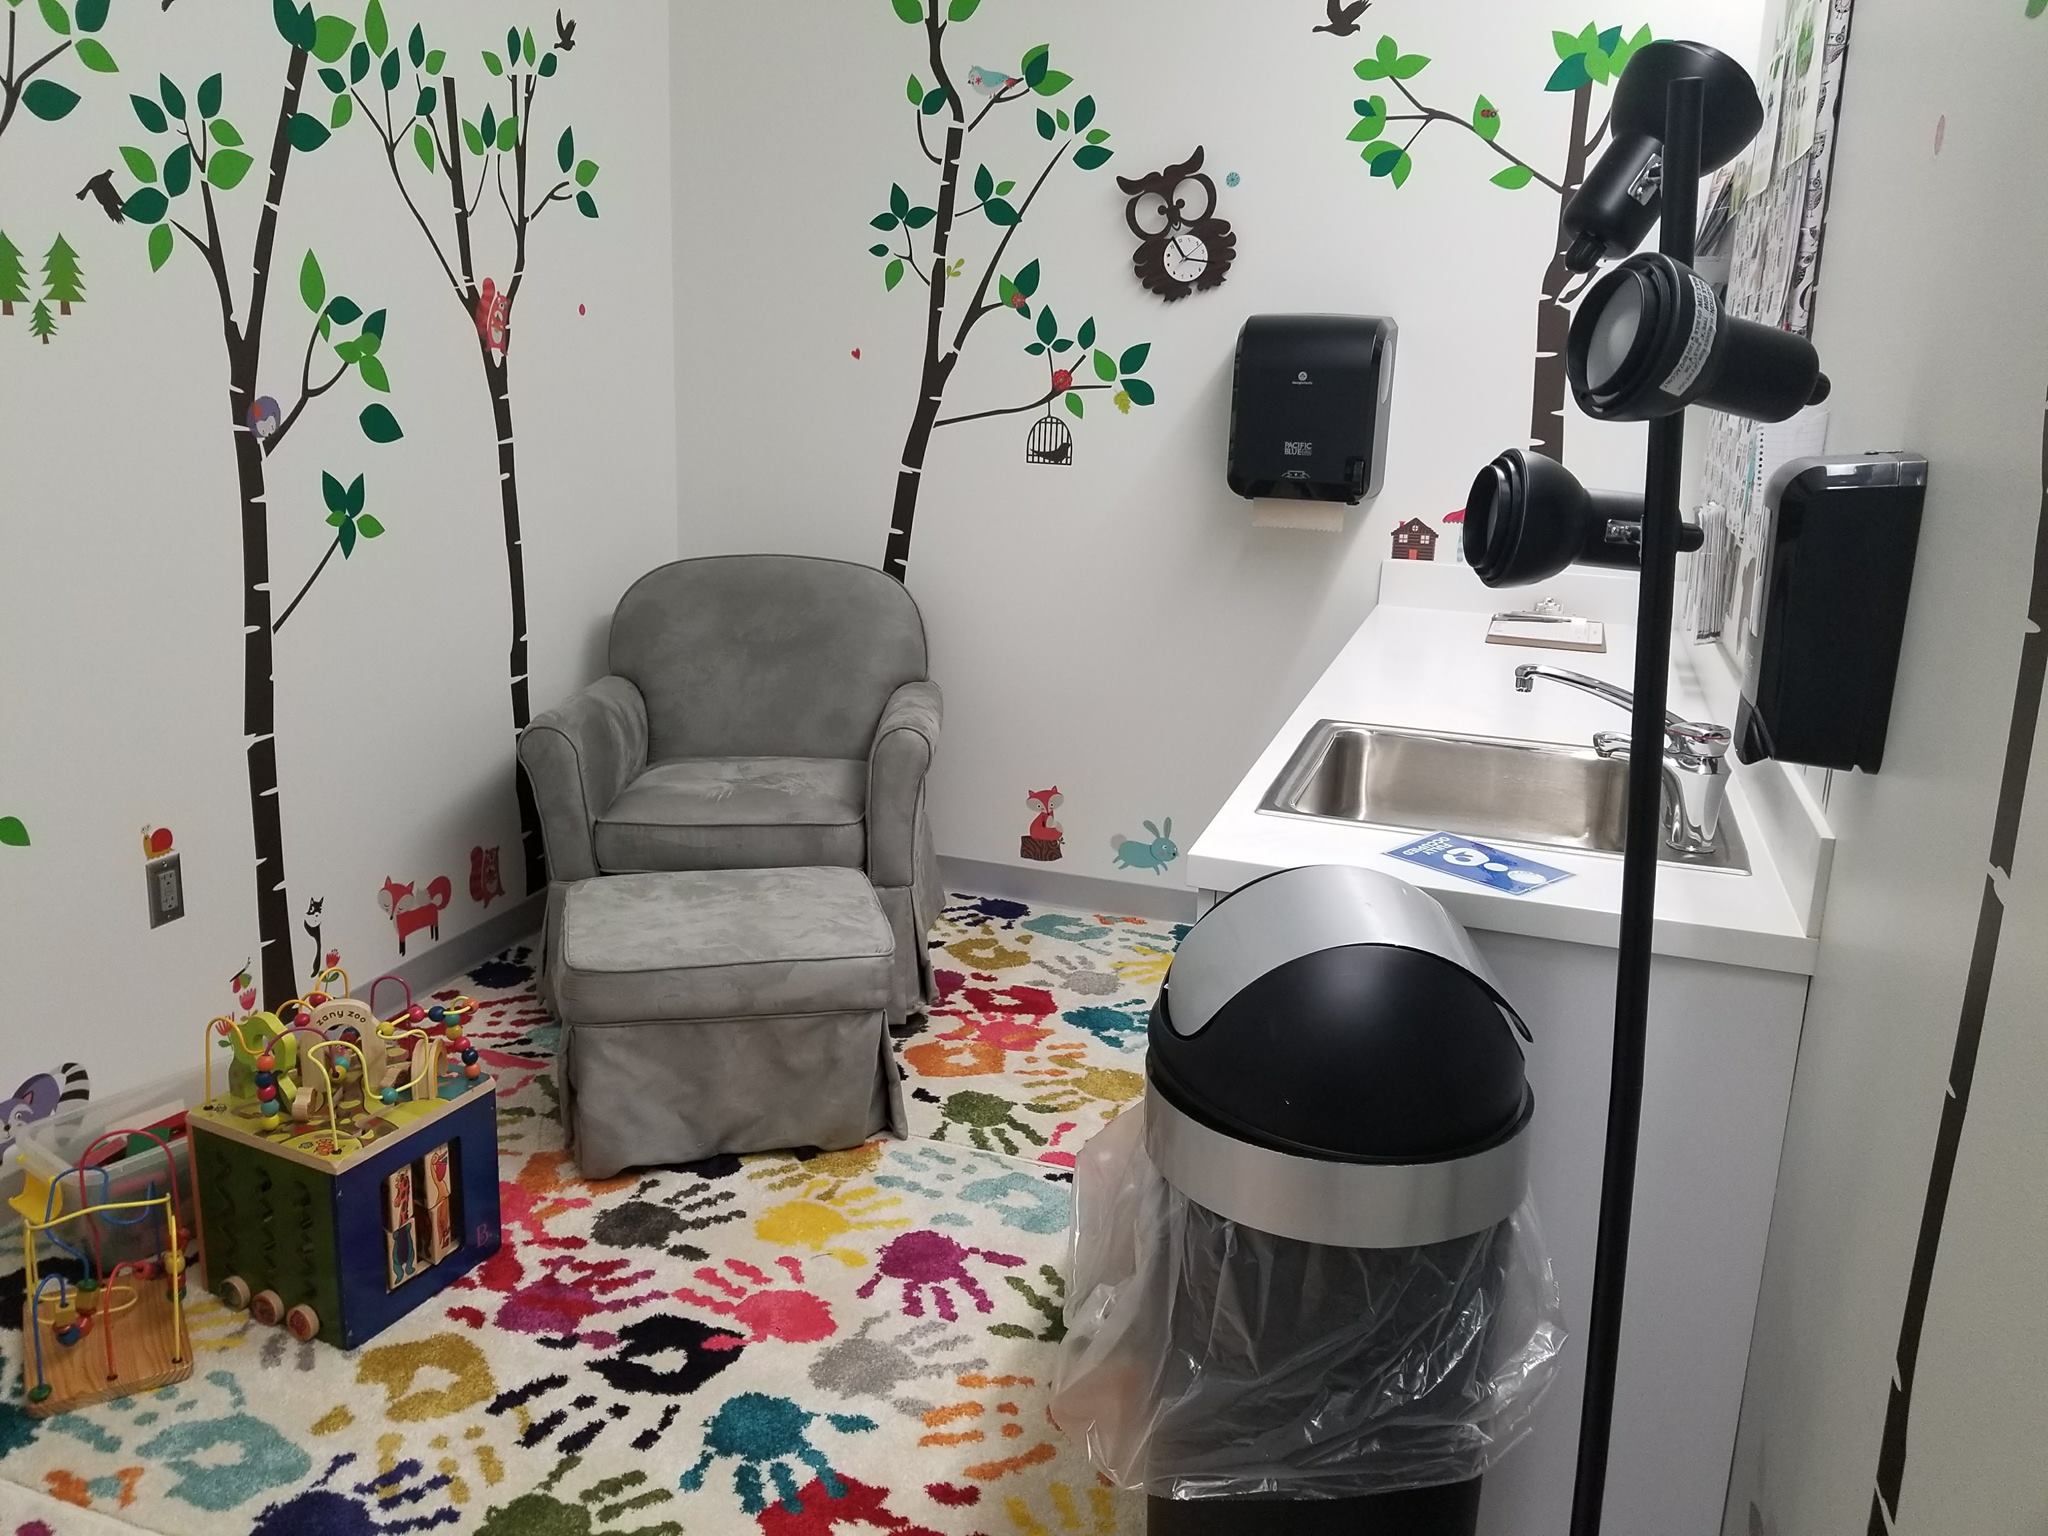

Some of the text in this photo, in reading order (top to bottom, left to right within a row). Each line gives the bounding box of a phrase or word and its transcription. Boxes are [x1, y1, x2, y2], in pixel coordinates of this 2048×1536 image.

[1284, 441, 1312, 450] PACIFIC
[1284, 448, 1302, 456] BLUE
[1402, 837, 1450, 856] OCCUPIED
[315, 1010, 367, 1026] zany zoo
